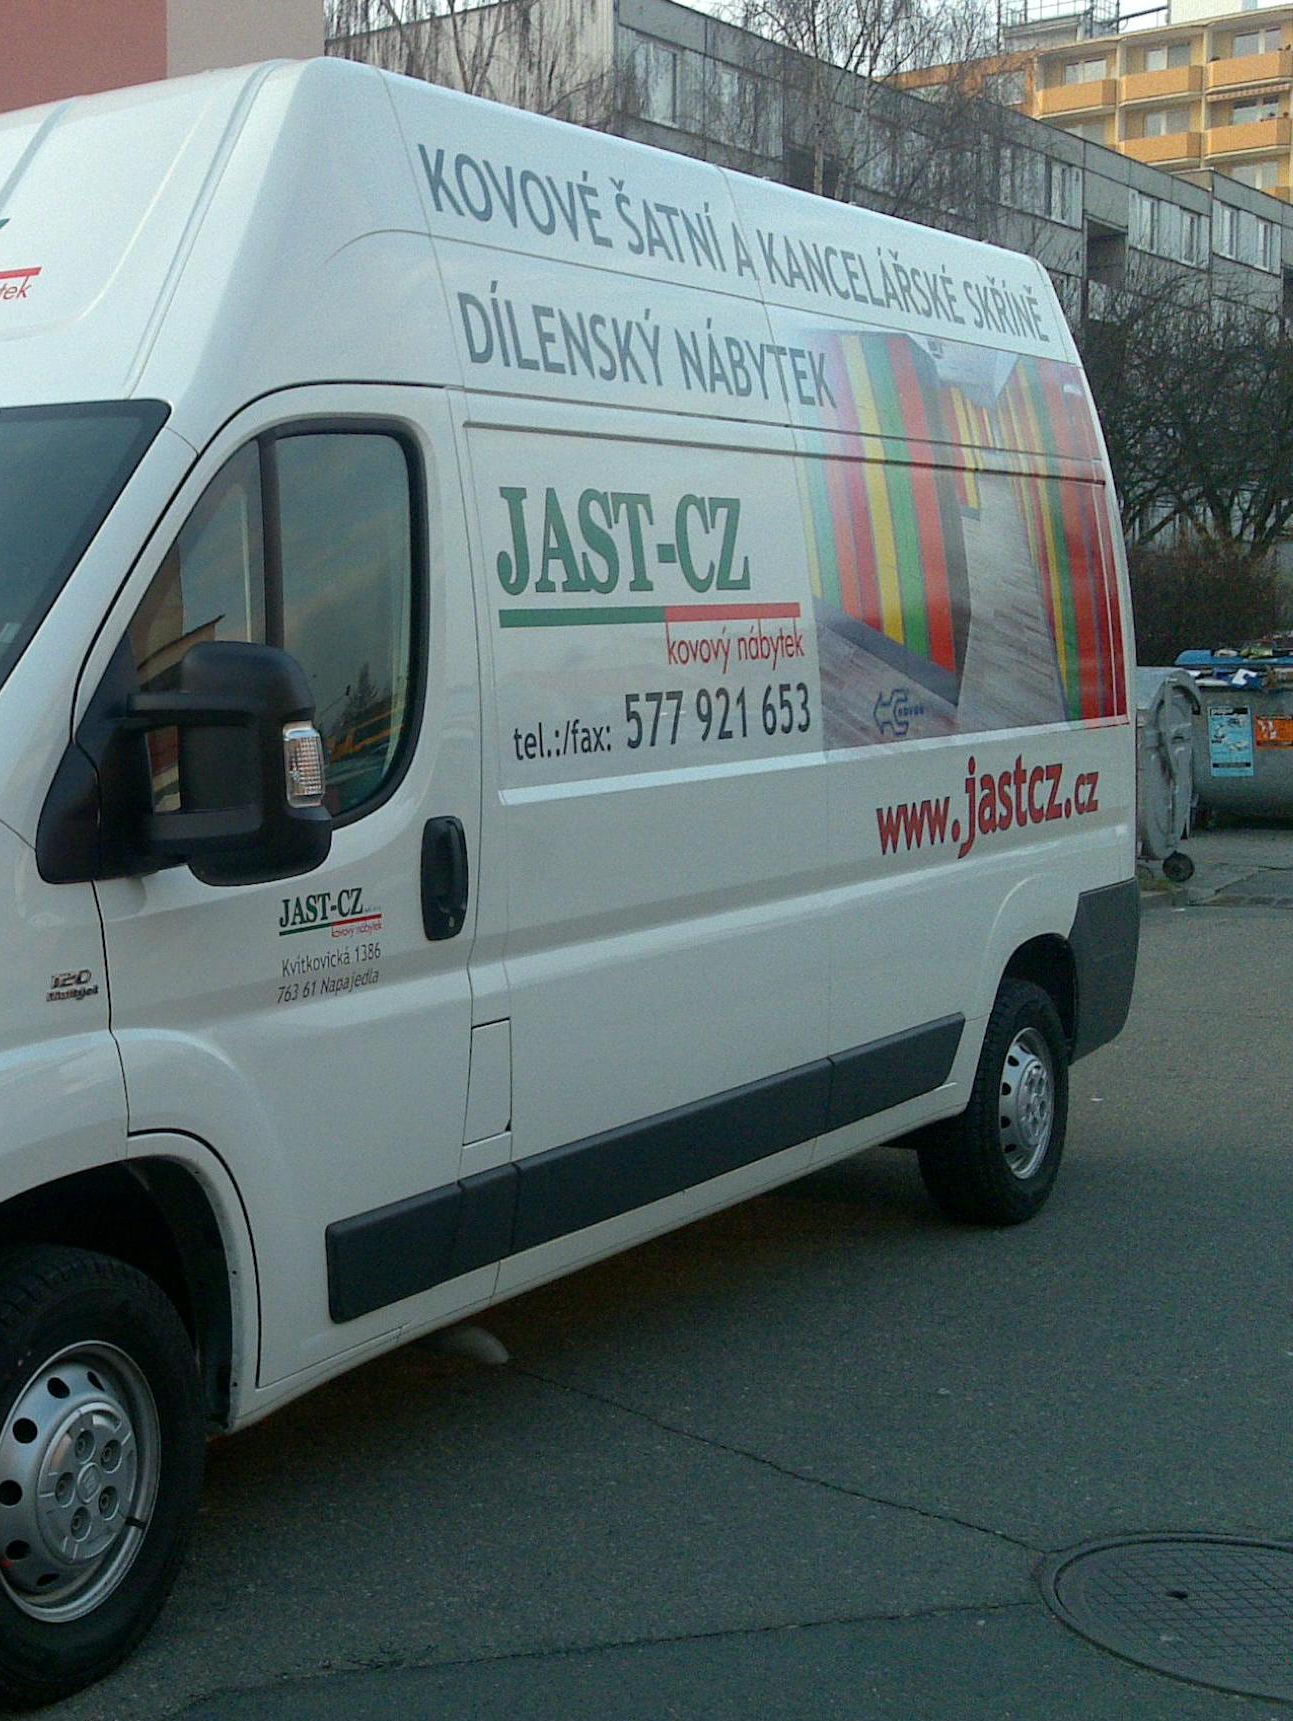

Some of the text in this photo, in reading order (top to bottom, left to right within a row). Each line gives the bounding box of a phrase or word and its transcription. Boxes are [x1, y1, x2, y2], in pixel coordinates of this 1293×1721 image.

[417, 143, 1051, 342] KOVOVÉ ŠATNÍ A KANCELÁŘSKÉ SKŘÍNĚ
[457, 280, 837, 408] DÍLENSKÝ NÁBYTEK
[497, 486, 751, 596] JAST-CZ
[666, 618, 804, 674] kovový nábytek
[625, 690, 684, 750] 577
[696, 686, 749, 742] 921
[761, 682, 811, 735] 653
[875, 753, 1100, 859] www.jastcz.cz
[279, 887, 363, 928] JAST-CZ
[277, 968, 379, 1003] 763 61 Napajedla
[354, 942, 381, 963] 1386
